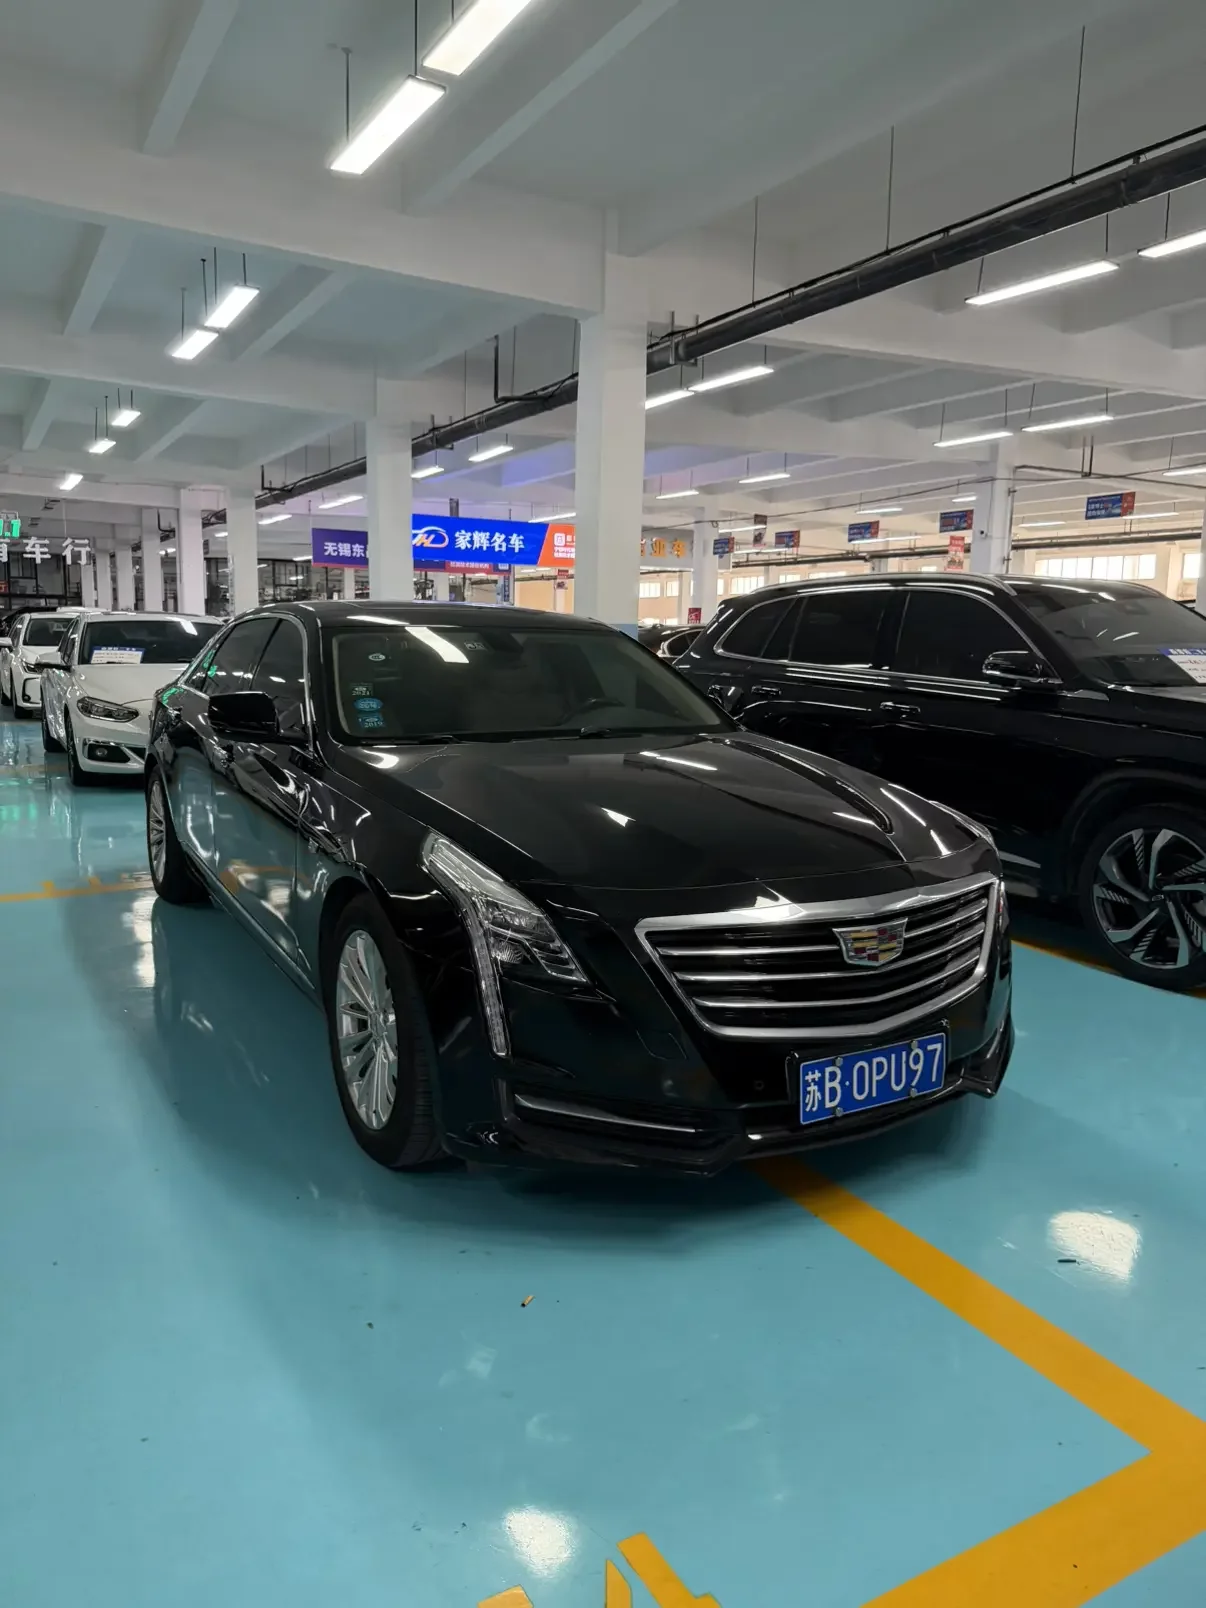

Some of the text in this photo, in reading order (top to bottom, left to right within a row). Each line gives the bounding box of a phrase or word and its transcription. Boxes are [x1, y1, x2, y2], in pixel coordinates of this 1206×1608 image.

[323, 541, 369, 558] 无锡东
[454, 529, 525, 553] 家辉名车
